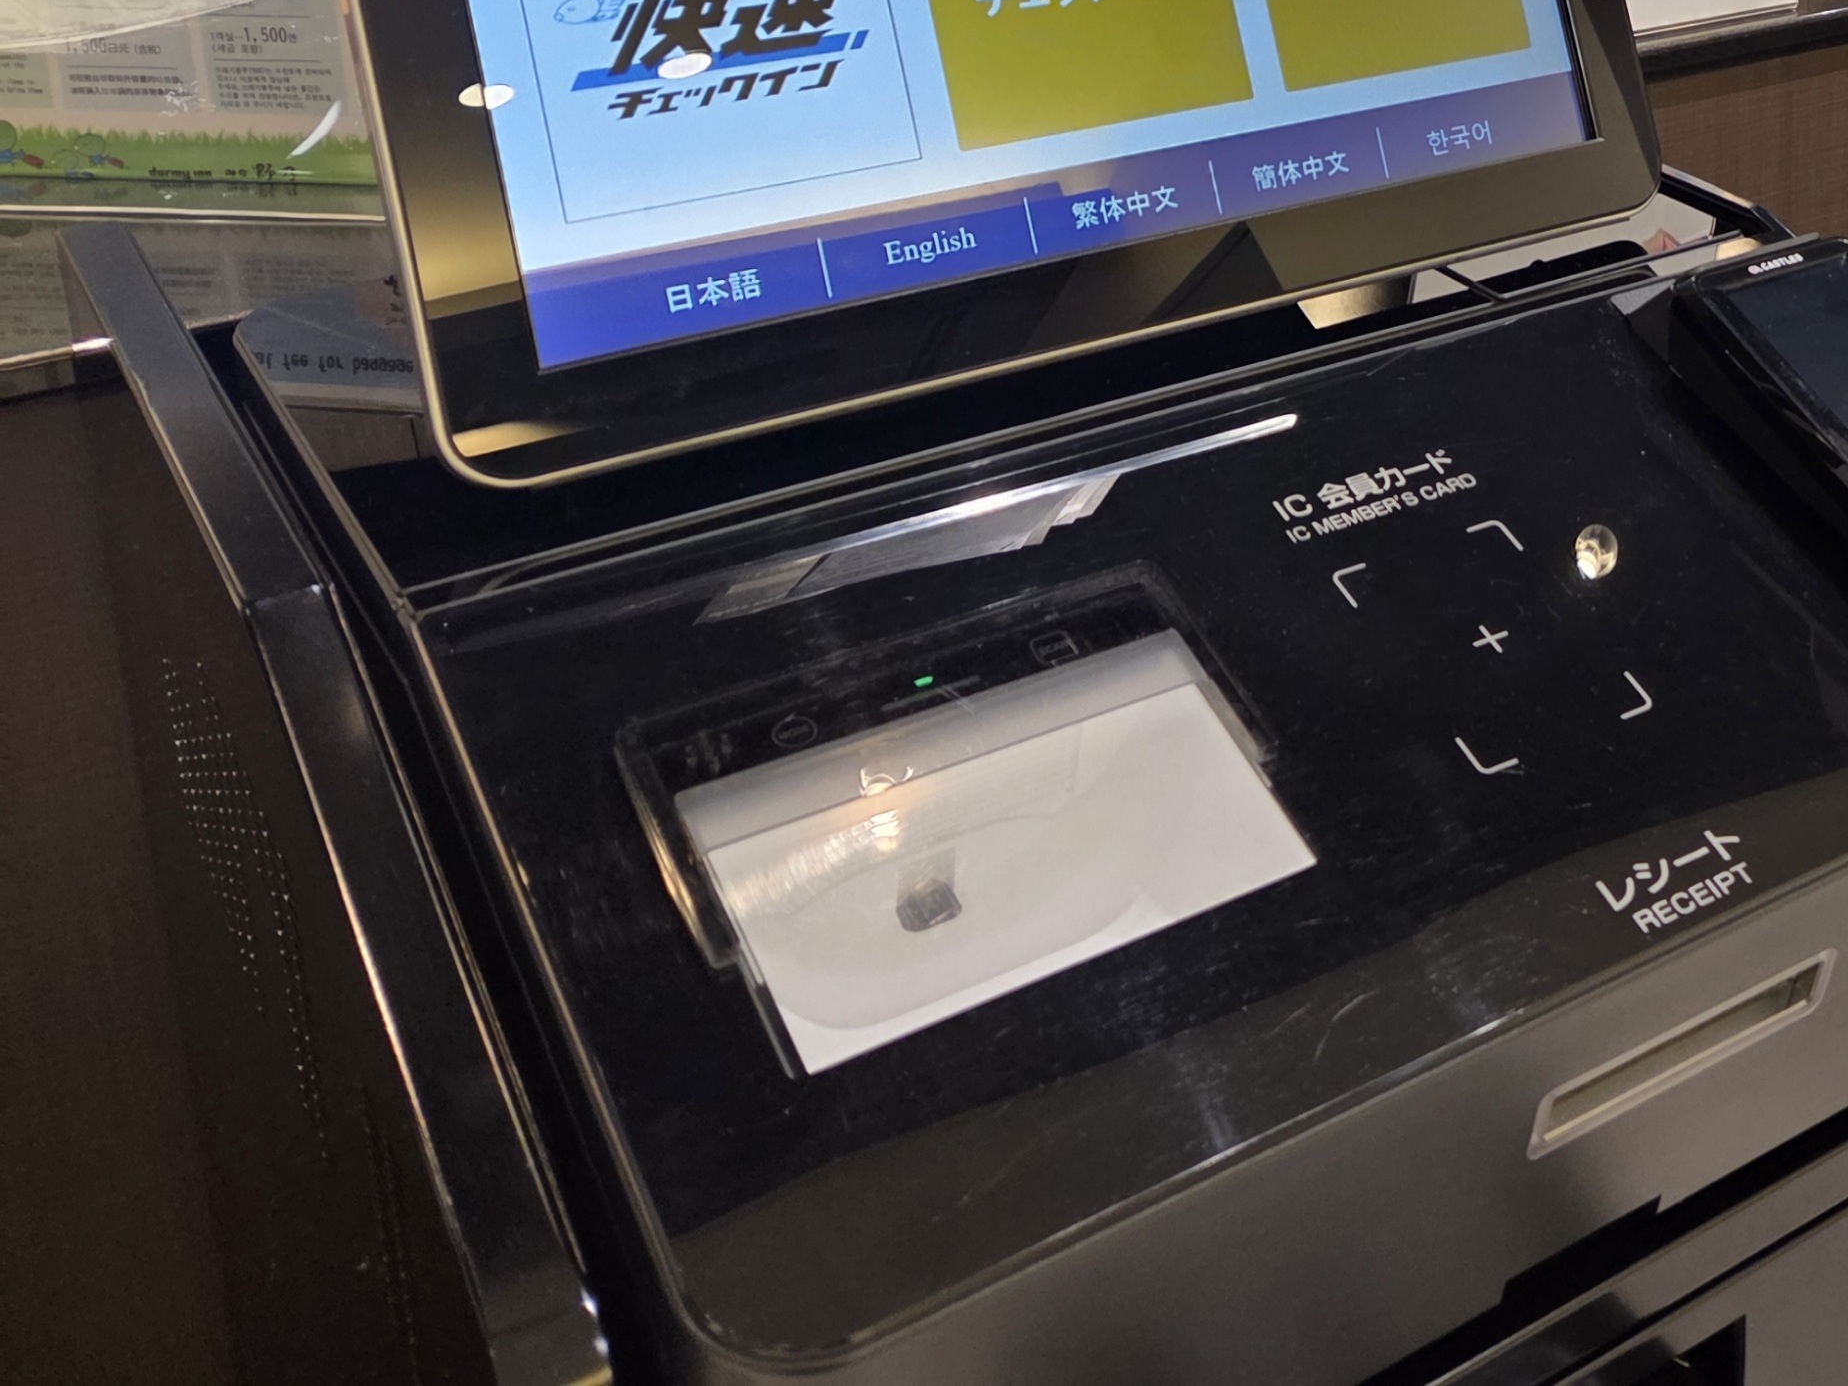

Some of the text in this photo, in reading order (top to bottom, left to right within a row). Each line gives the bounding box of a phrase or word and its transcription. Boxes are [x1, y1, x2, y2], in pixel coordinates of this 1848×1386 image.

[607, 59, 844, 120] チェックイン
[665, 121, 1494, 313] 日本語 English 繁体中文 簡体中文 한국어
[1760, 253, 1803, 271] CASTLES
[1272, 448, 1454, 522] IC 会員カード
[1285, 472, 1478, 544] IC MEMBER'S CARD
[1596, 830, 1741, 912] レシート
[1632, 862, 1756, 934] RECEIPT
